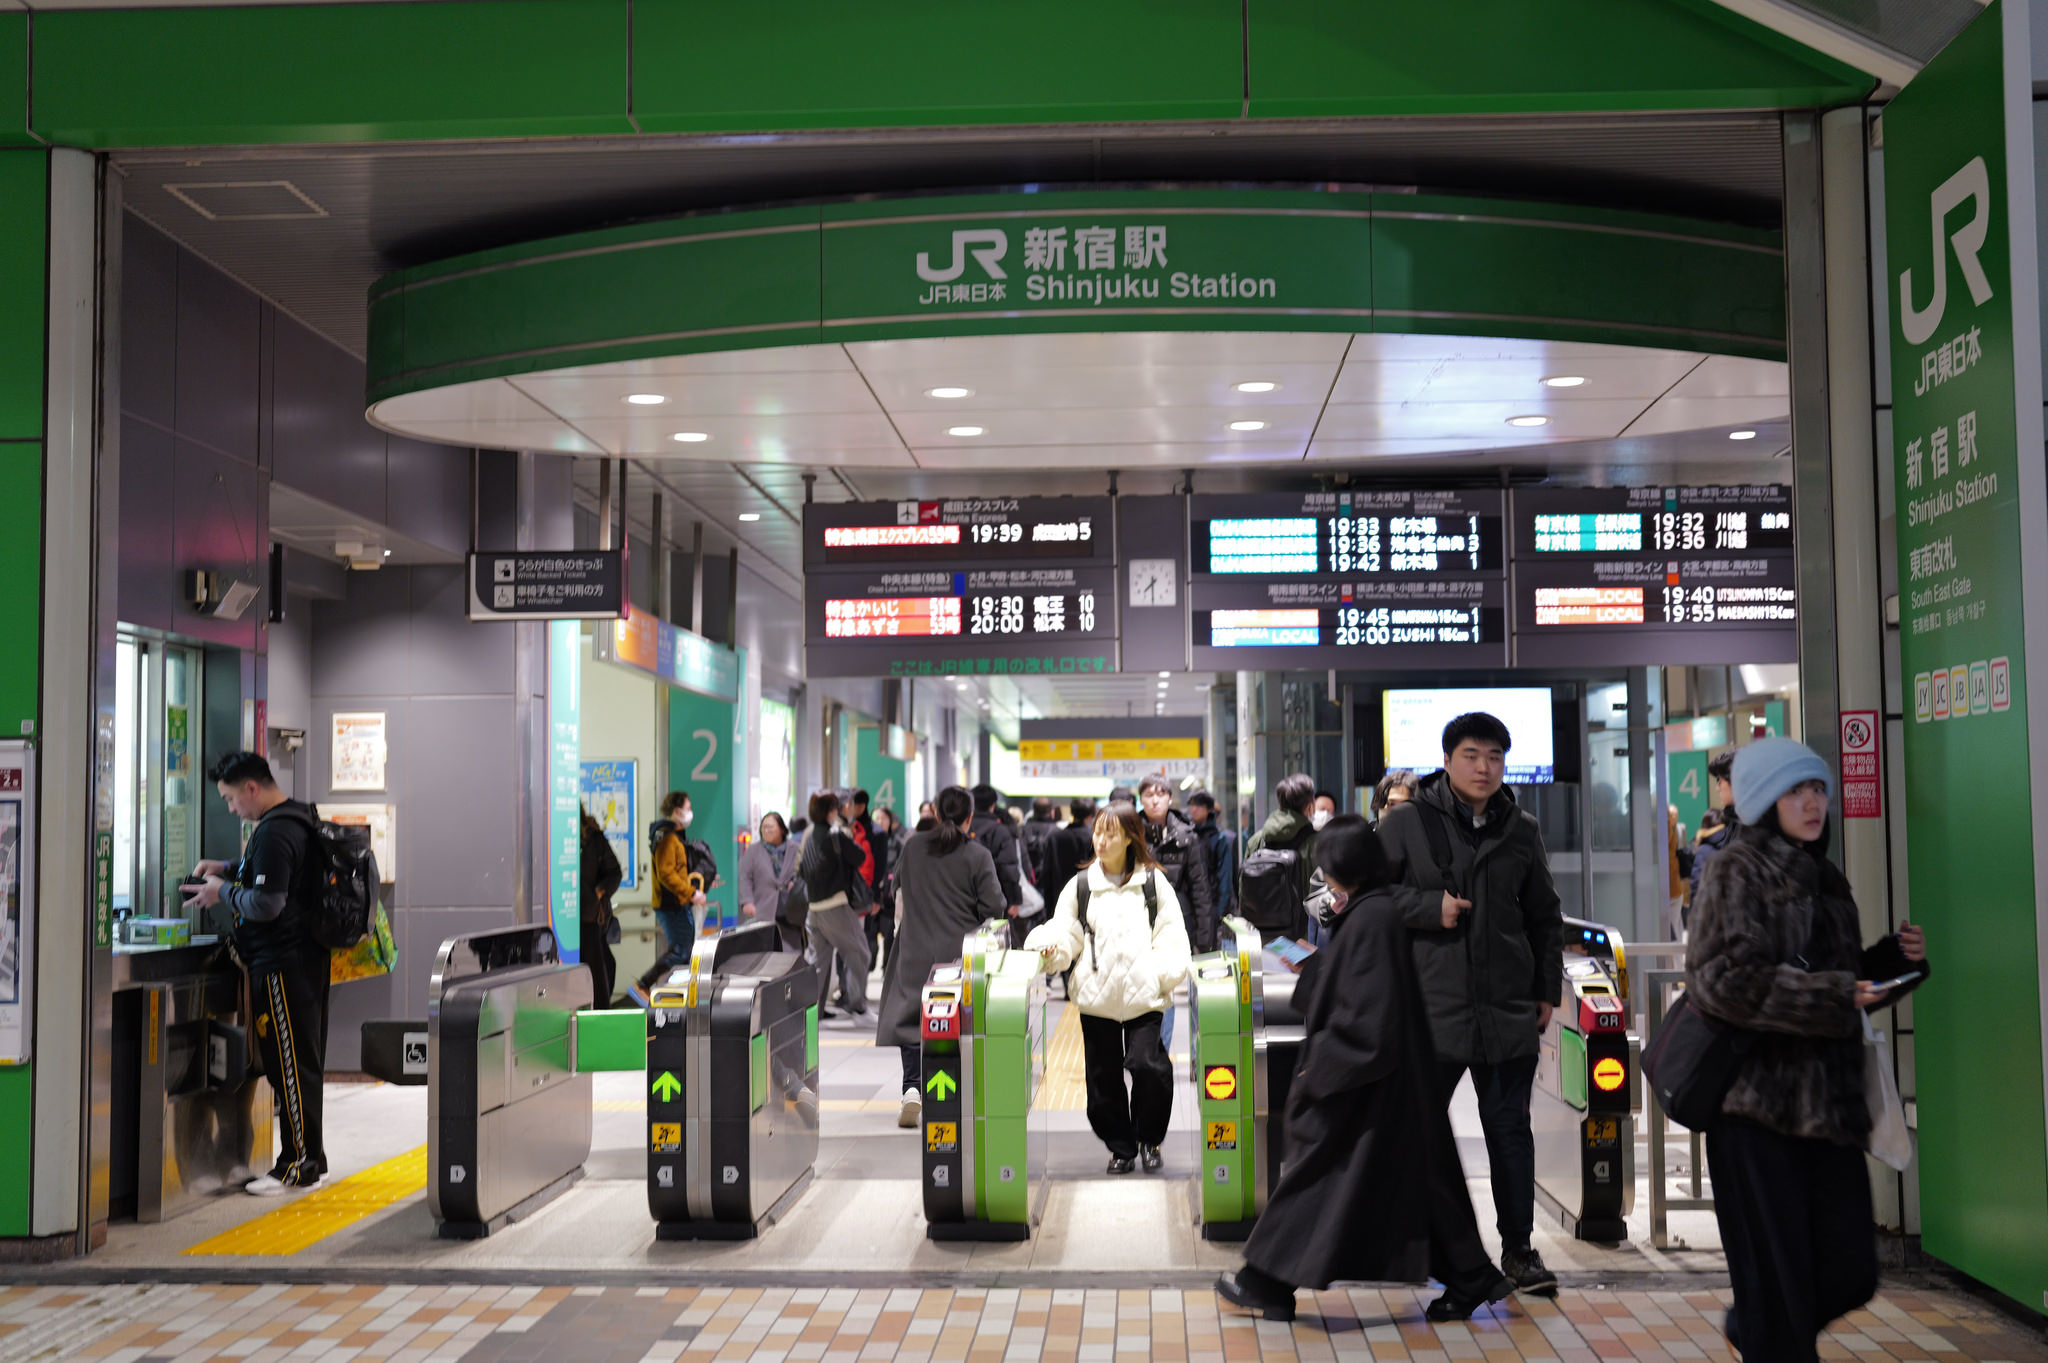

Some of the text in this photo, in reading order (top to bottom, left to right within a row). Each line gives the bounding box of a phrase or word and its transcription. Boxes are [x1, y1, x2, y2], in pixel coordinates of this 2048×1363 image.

[916, 228, 1008, 282] JR
[1024, 225, 1168, 271] 新宿駅
[1900, 155, 1993, 345] JR
[918, 283, 1007, 305] JR東日本
[1026, 271, 1276, 305] Shinjuku Station
[1914, 324, 1982, 397] JR東日本
[1905, 410, 1978, 490] 新宿駅
[943, 500, 1019, 513] 成田エクスプレス
[1908, 471, 1998, 527] Shinjuku Station
[1328, 517, 1381, 536] 19:33
[1469, 515, 1478, 534] 1
[1653, 512, 1704, 531] 19:32
[971, 524, 1023, 543] 19:39
[1079, 522, 1091, 541] 5
[1654, 531, 1705, 549] 19:36
[1328, 535, 1381, 553] 19:36
[1468, 534, 1480, 552] 3
[1328, 553, 1381, 572] 19:42
[1470, 552, 1478, 570] 1
[1909, 534, 1957, 582] 東南改札
[1596, 589, 1643, 604] LOCAL
[1663, 586, 1715, 604] 19:40
[1911, 576, 1971, 610] South East Gate
[972, 596, 1024, 615] 19:30
[1079, 594, 1094, 613] 10
[1079, 612, 1094, 632] 10
[1338, 609, 1389, 627] 19:45
[1471, 607, 1479, 625] 1
[1596, 607, 1643, 622] LOCAL
[1663, 604, 1716, 623] 19:55
[971, 614, 1024, 634] 20:00
[1336, 627, 1389, 645] 20:00
[1392, 628, 1435, 643] ZUSHI
[1472, 626, 1479, 644] 1
[1954, 681, 1965, 702] JB
[1974, 678, 1985, 698] JA
[1995, 673, 2005, 695] JS
[1919, 687, 1928, 707] JY
[1936, 684, 1946, 705] JC
[691, 729, 718, 781] 2
[1679, 768, 1701, 799] 4
[874, 778, 896, 810] 4
[929, 1019, 949, 1032] QR
[1600, 1014, 1619, 1027] QR
